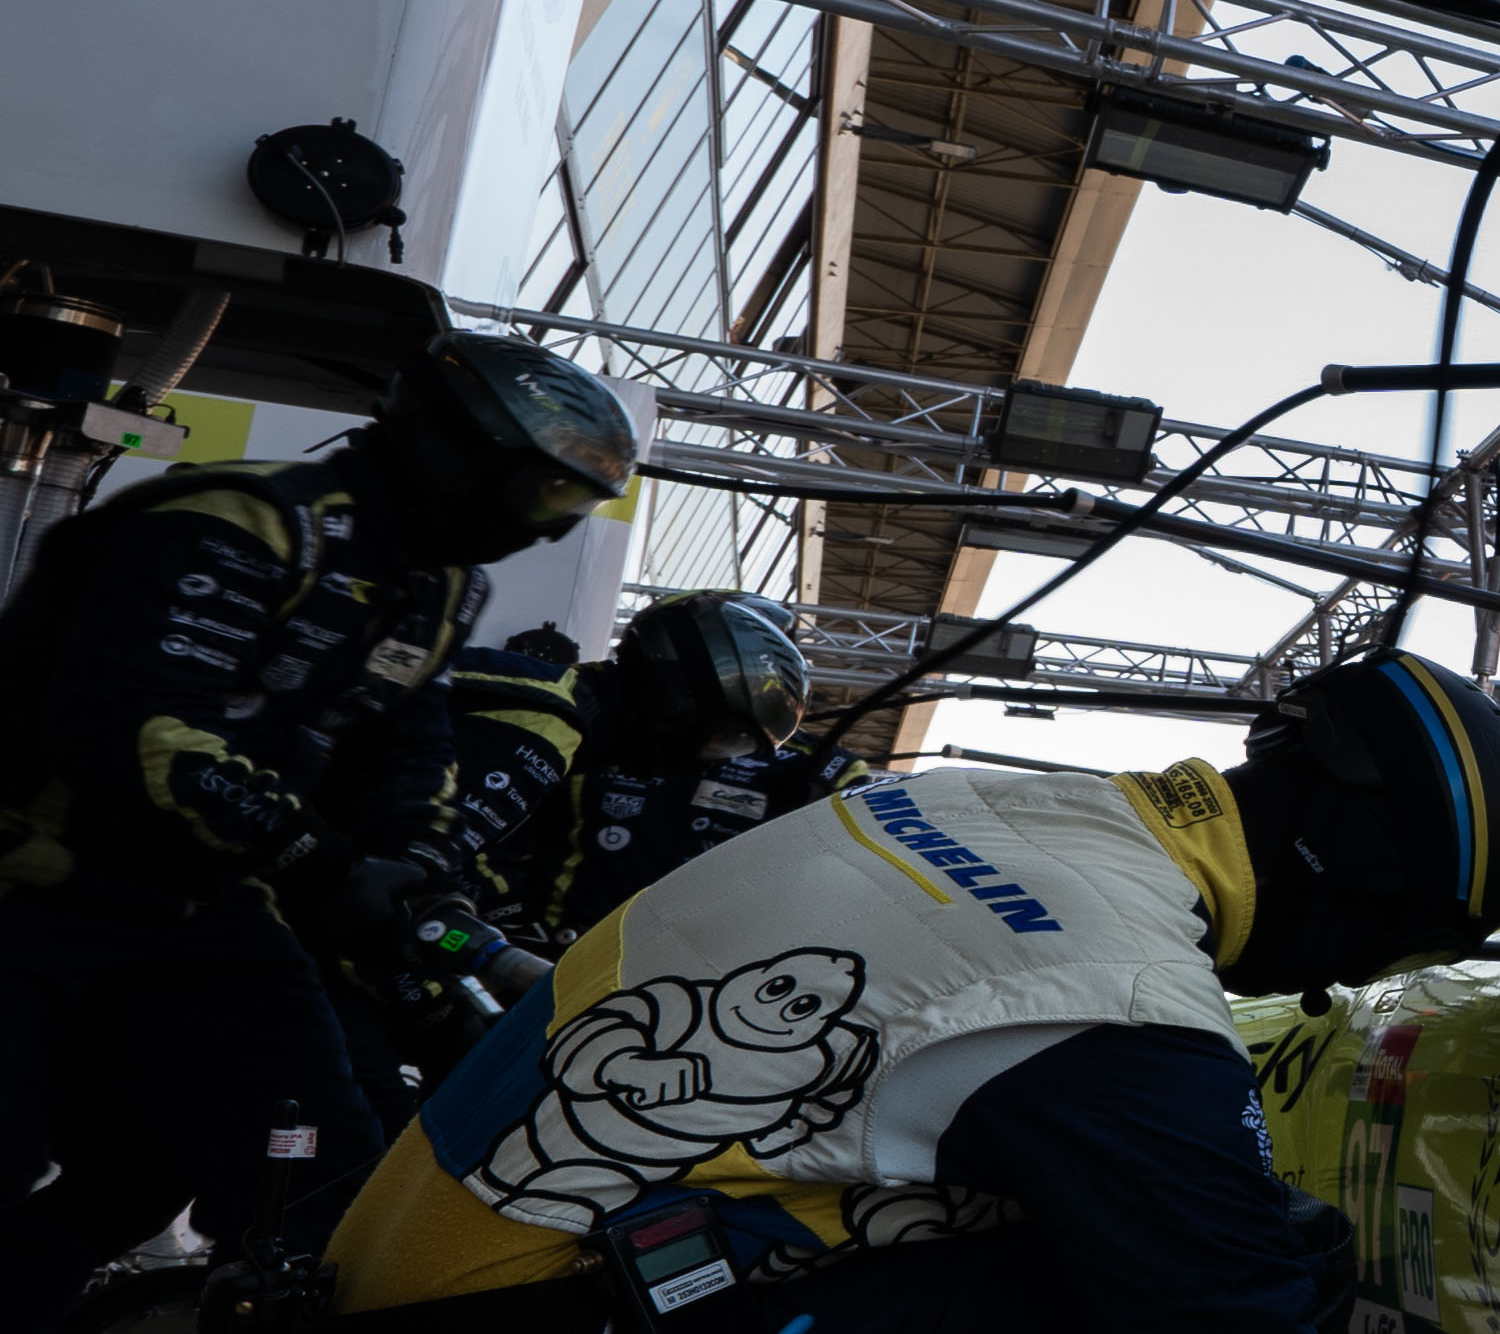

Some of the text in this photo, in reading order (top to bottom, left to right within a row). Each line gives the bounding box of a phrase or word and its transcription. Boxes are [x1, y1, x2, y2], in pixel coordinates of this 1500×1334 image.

[861, 787, 1064, 936] MICHELIN
[1344, 1118, 1396, 1287] 97
[1398, 1207, 1435, 1301] PRO
